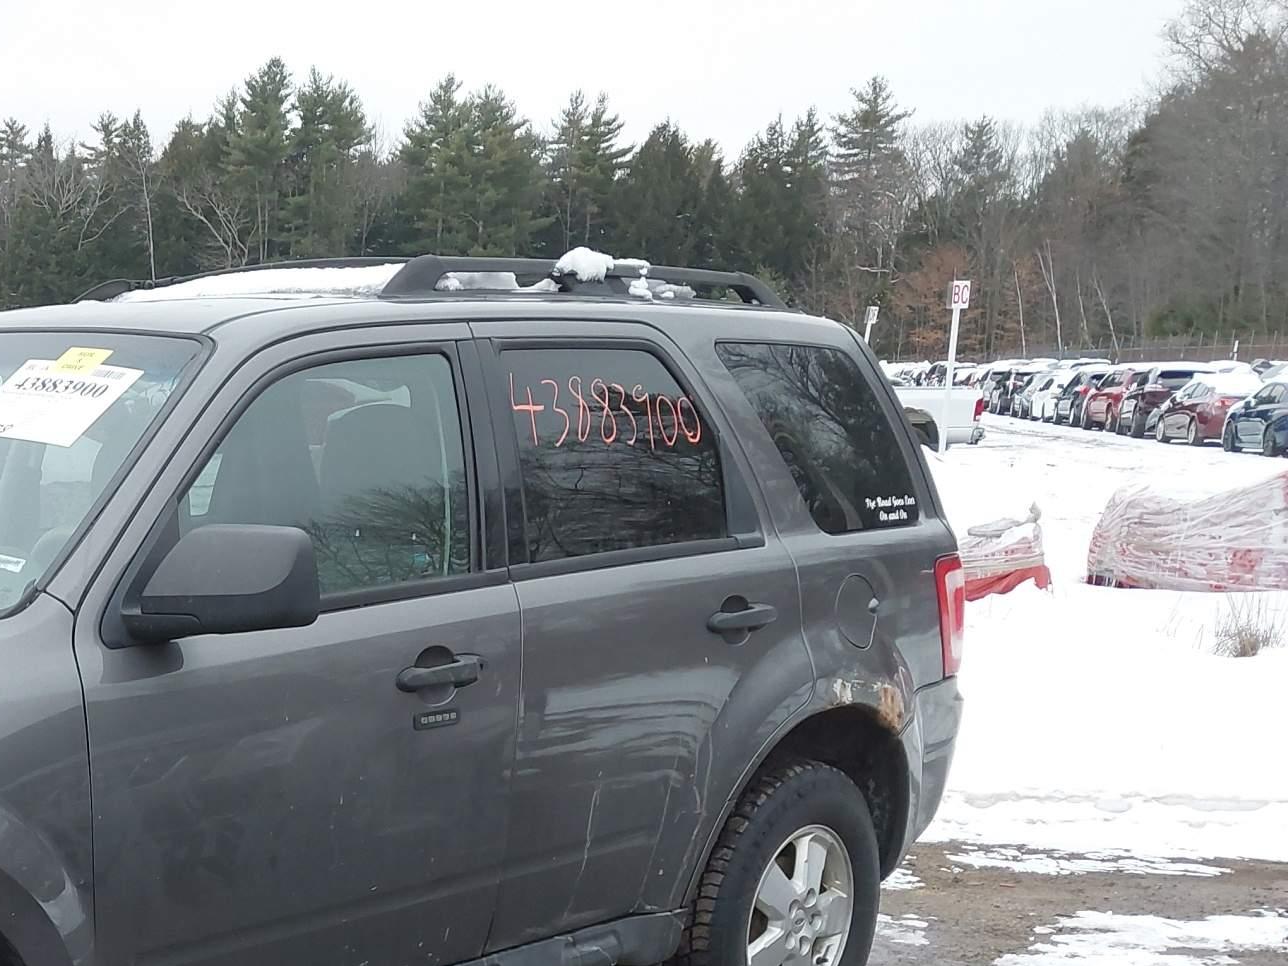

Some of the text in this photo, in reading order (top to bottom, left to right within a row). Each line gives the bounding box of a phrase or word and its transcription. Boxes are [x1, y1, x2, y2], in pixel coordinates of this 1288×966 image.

[953, 284, 969, 304] BC
[14, 376, 110, 399] 43883900
[509, 372, 702, 450] 43883900
[877, 496, 892, 507] Road
[879, 510, 888, 521] On
